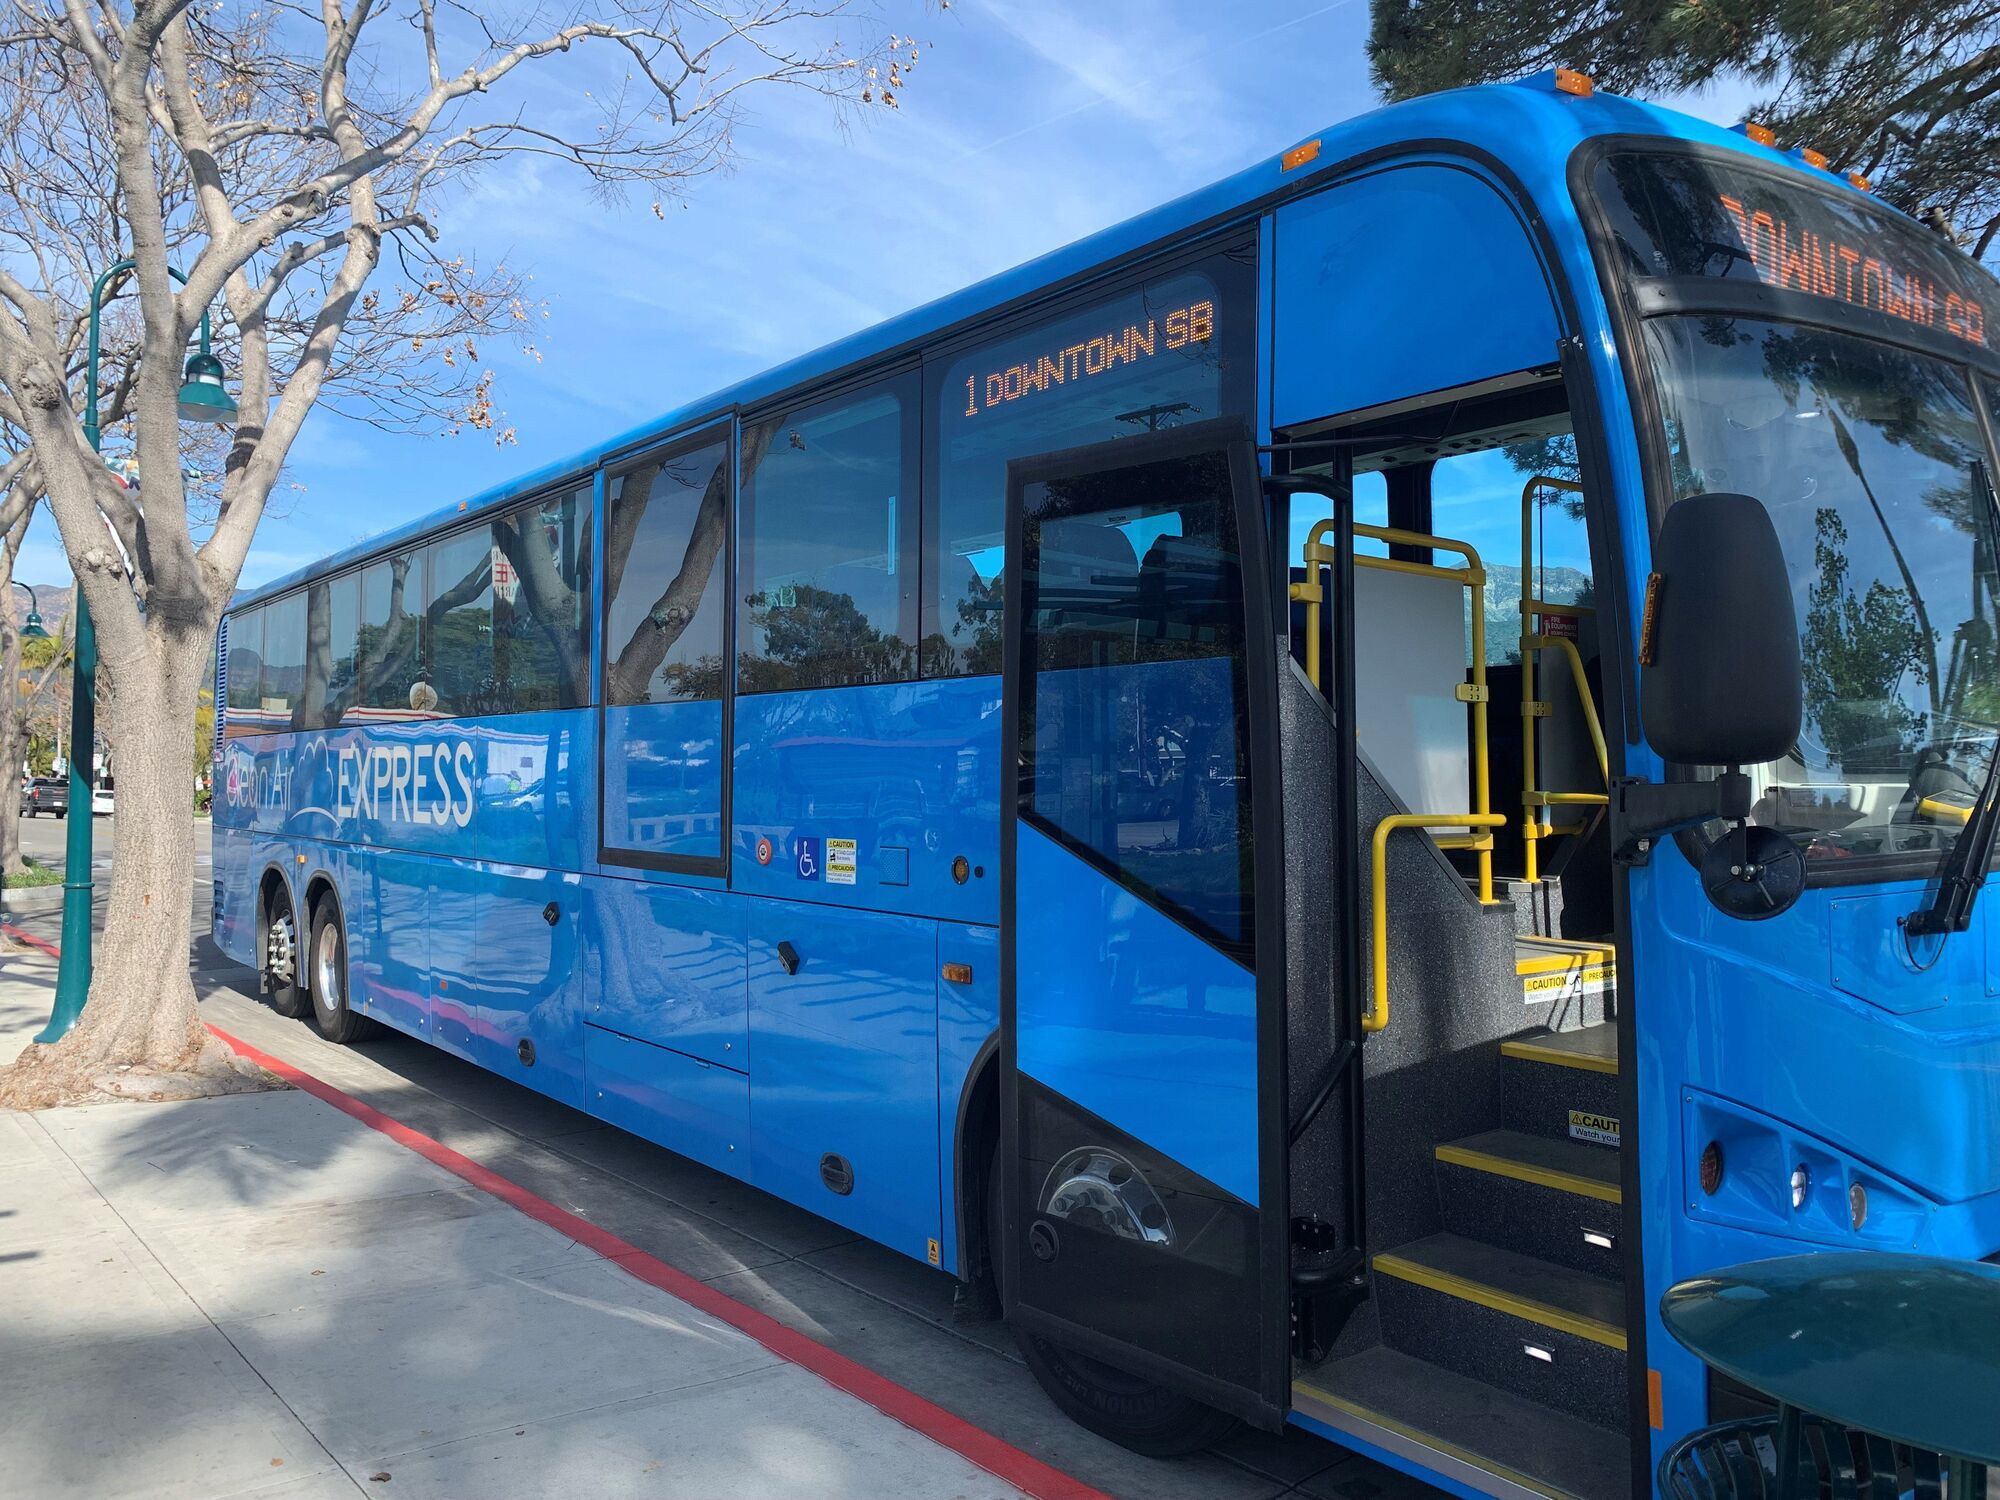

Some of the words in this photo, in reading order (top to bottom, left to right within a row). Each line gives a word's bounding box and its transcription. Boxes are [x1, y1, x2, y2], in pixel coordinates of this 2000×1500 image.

[965, 375, 978, 416] 1
[986, 319, 1154, 407] DOWNTOWN
[1166, 301, 1213, 350] SB
[227, 752, 268, 809] Clean
[270, 749, 295, 811] Air
[337, 740, 475, 828] EXPRESS
[1532, 976, 1567, 991] CAUTION
[1575, 1126, 1600, 1139] Watch
